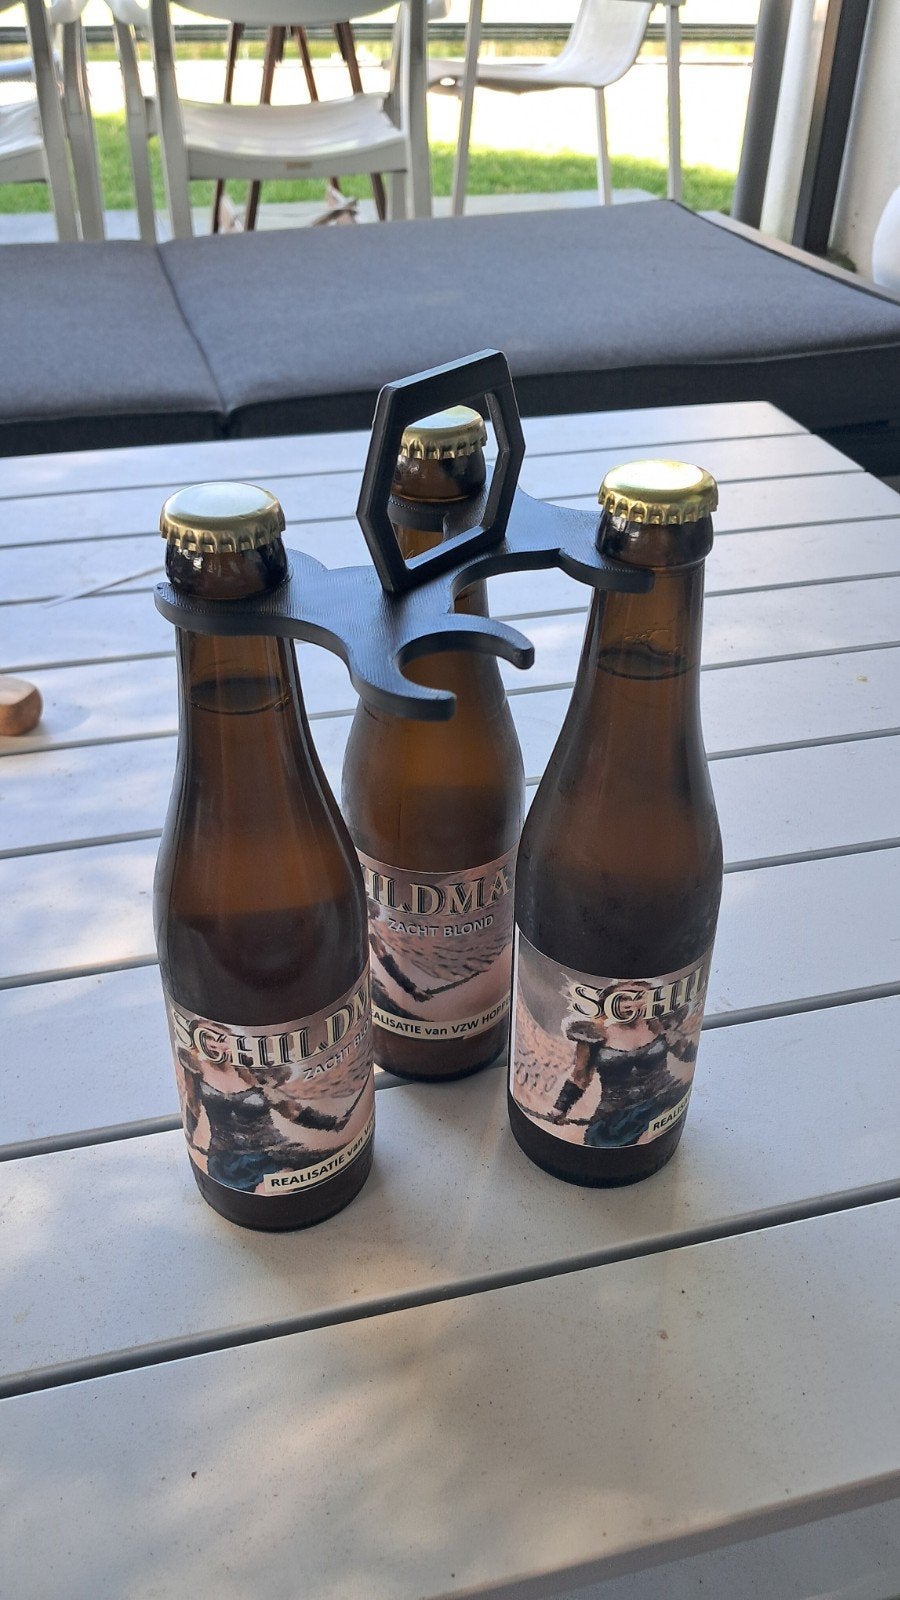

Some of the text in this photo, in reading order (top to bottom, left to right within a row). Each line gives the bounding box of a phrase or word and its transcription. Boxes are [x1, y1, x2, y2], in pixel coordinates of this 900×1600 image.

[387, 914, 494, 938] ZACHT BLOND
[425, 1027, 447, 1036] van
[451, 1018, 479, 1034] VZW
[303, 1042, 351, 1082] ZACHT
[271, 1154, 345, 1187] REALISATIE
[347, 1137, 363, 1156] van
